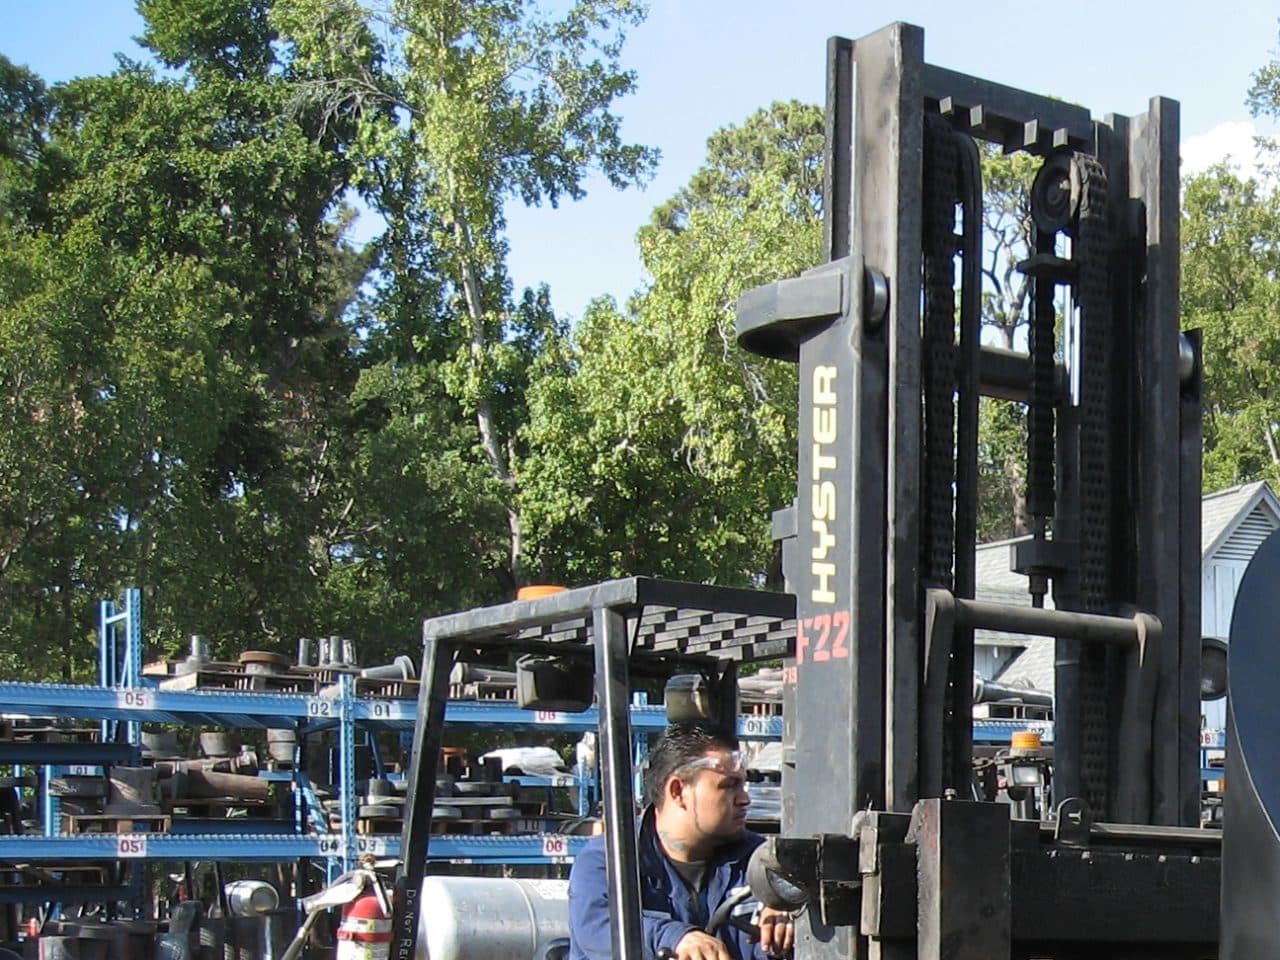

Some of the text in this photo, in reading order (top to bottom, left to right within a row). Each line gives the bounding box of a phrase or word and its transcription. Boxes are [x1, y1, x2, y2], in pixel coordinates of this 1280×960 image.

[812, 365, 837, 603] HYSTER
[796, 610, 850, 665] F22
[125, 692, 145, 706] 05
[310, 702, 329, 716] 02
[374, 704, 391, 717] 01
[120, 840, 140, 854] 05
